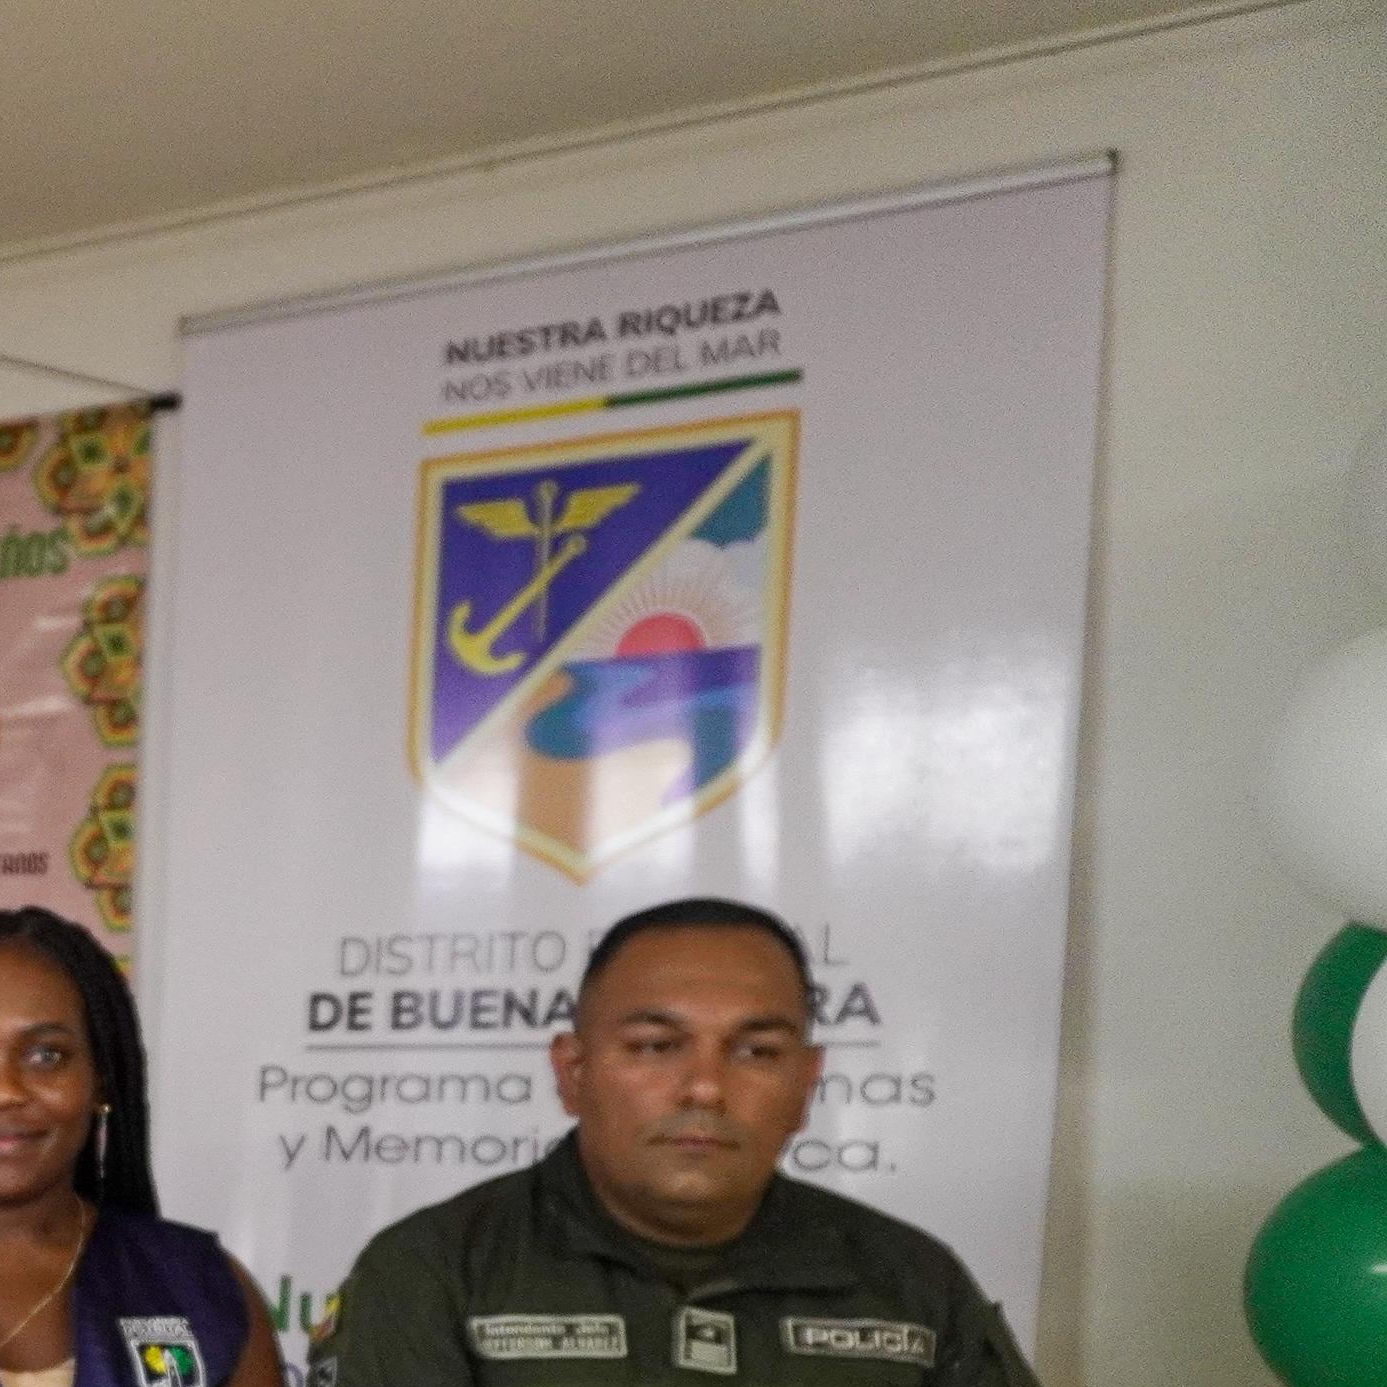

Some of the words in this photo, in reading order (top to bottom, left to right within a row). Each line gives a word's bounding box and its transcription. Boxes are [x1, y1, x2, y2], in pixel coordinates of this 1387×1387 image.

[445, 317, 607, 365] NUESTRA
[618, 288, 781, 338] RIQUEZA
[443, 370, 511, 403] NOS
[524, 352, 612, 393] VIENE
[626, 348, 685, 377] DEL
[698, 328, 781, 366] MAR
[339, 929, 567, 978] DISTRITO
[307, 990, 373, 1031] DE
[259, 1064, 533, 1115] Programa
[279, 1133, 307, 1171] y
[325, 1124, 544, 1166] Memori
